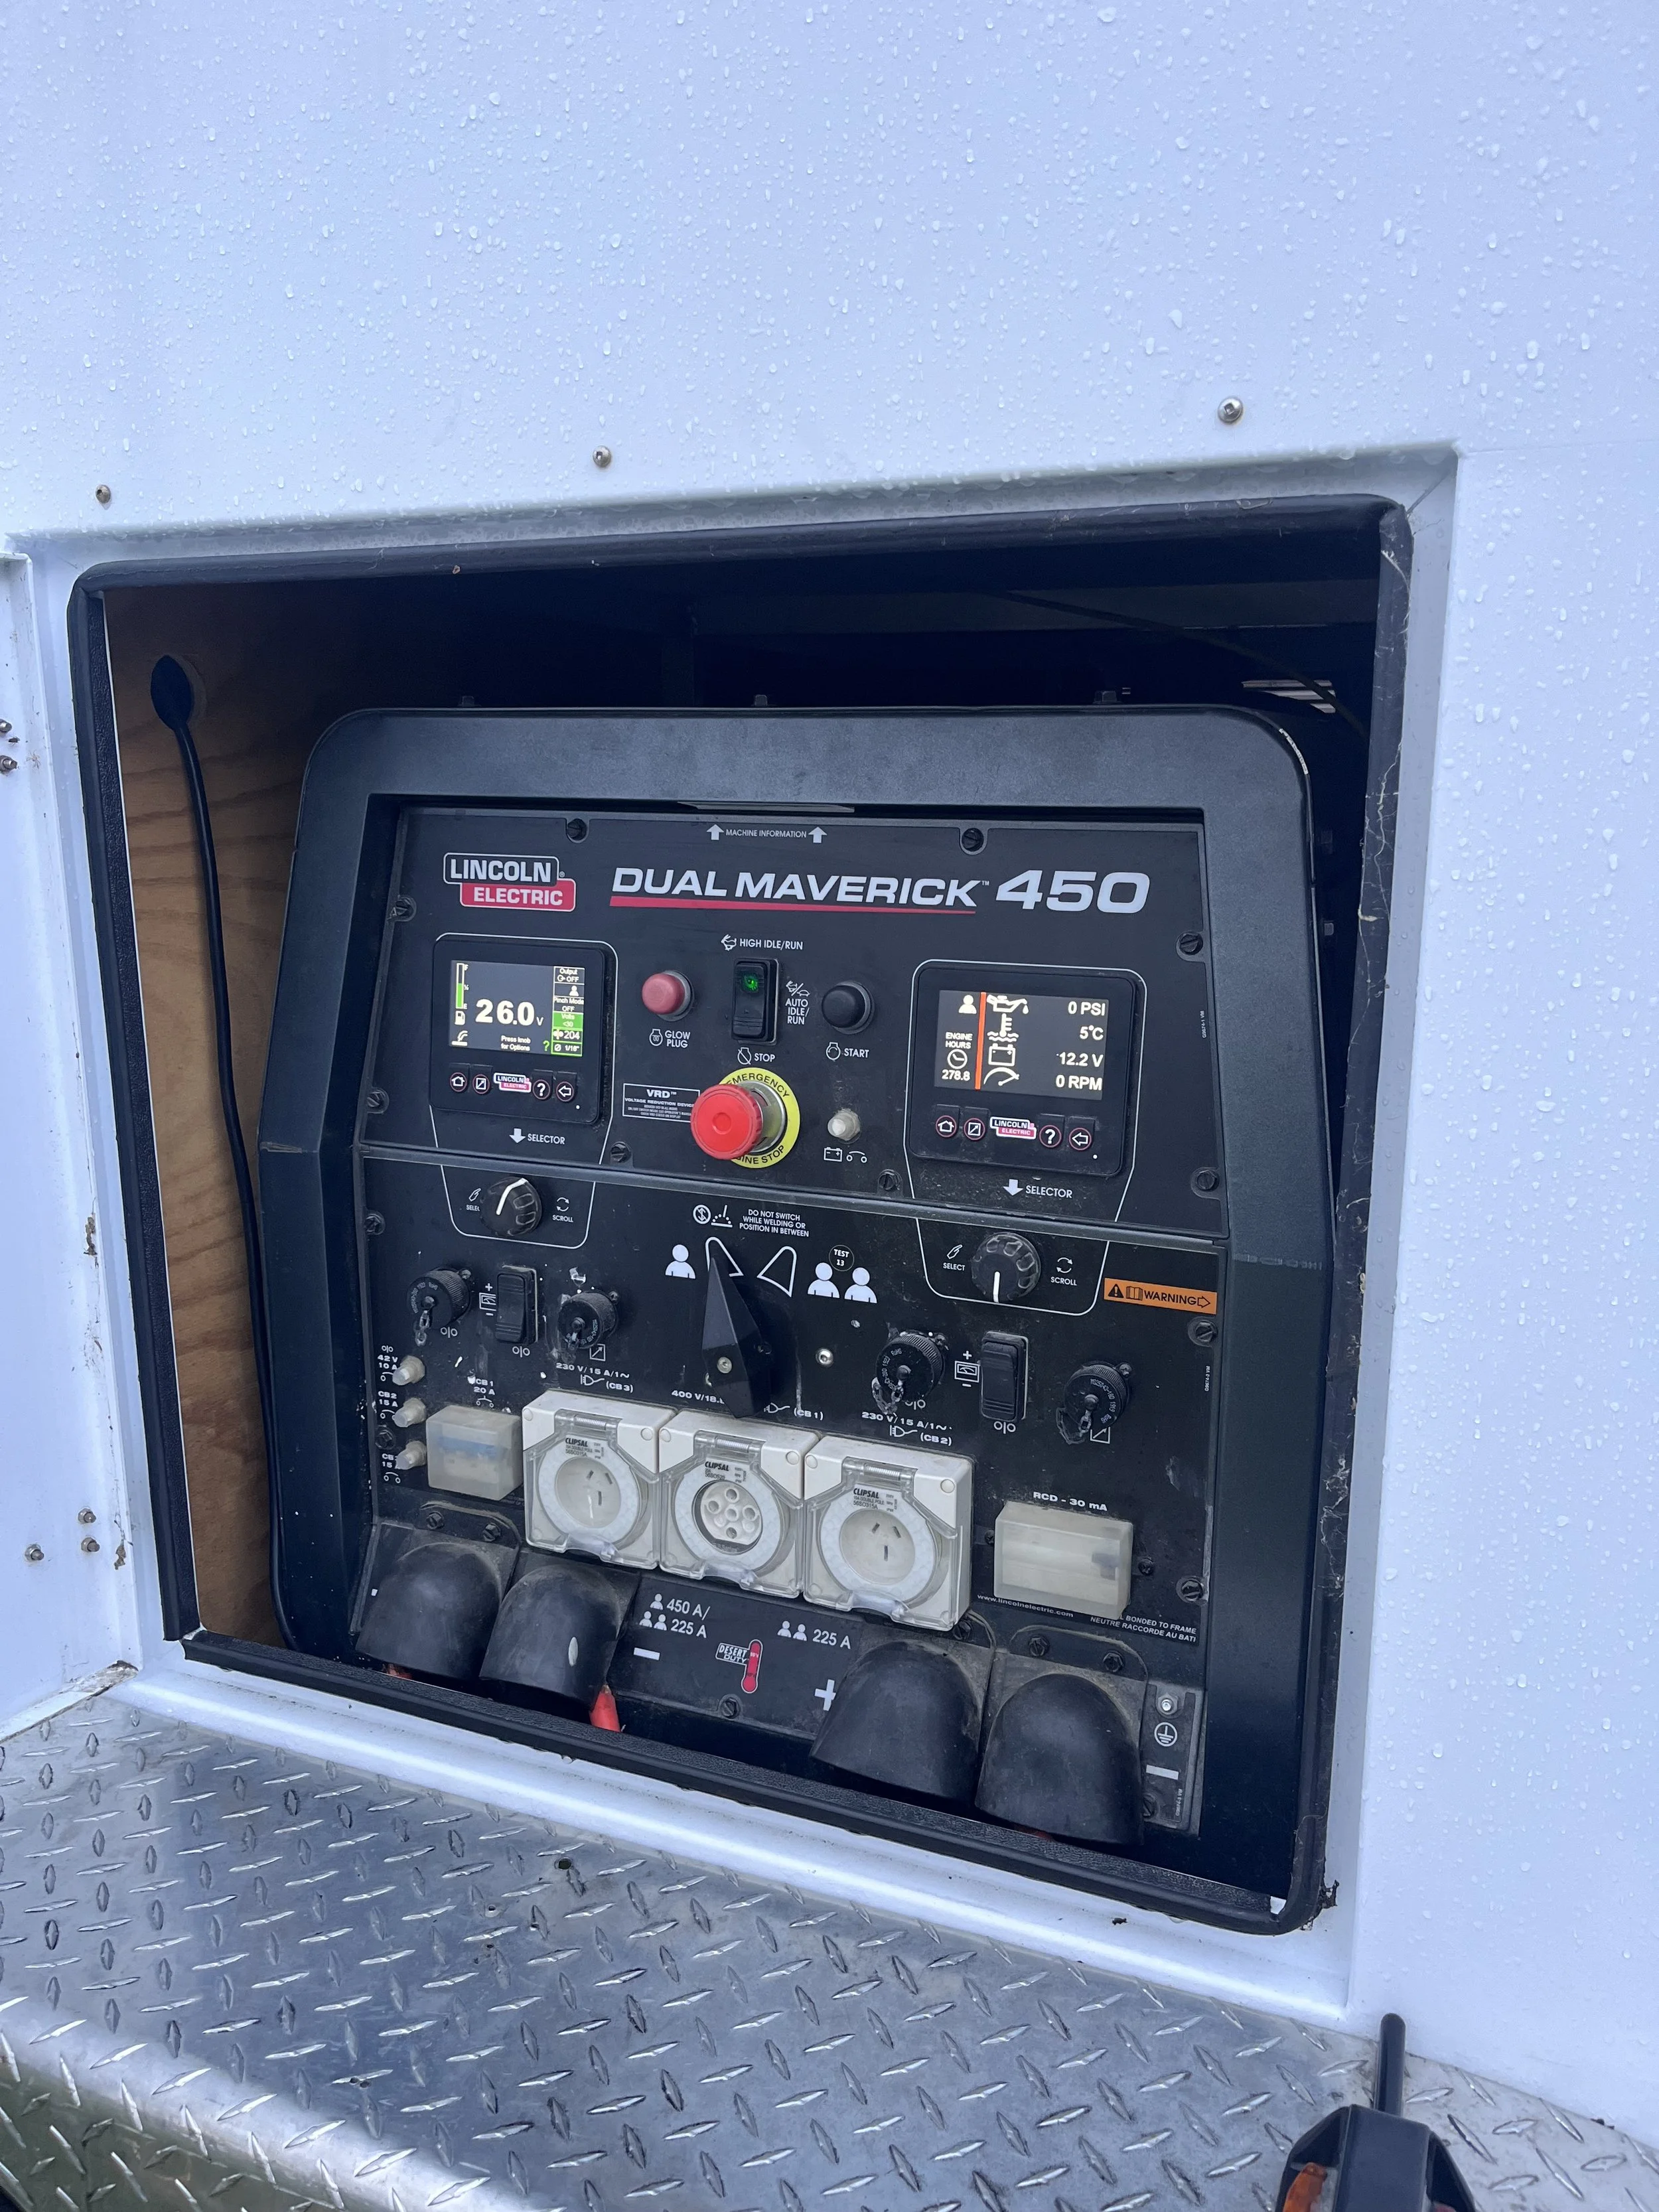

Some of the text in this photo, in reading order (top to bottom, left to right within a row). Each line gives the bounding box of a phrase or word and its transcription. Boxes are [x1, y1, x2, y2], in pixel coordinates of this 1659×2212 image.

[451, 859, 551, 882] LINCOLN
[612, 867, 727, 897] DUAL
[995, 869, 1150, 913] 450
[474, 887, 563, 906] ELECTRIC
[739, 938, 803, 950] HIGH IDLE/RUN
[785, 998, 808, 1007] AUTO
[475, 999, 543, 1026] 26.0 V
[788, 1007, 810, 1017] IDLE/
[1068, 1001, 1105, 1016] 0 PSI
[787, 1015, 804, 1025] RUN
[563, 1031, 580, 1039] 204
[664, 1030, 690, 1039] GLOW
[946, 1032, 973, 1041] ENGINE
[1080, 1025, 1104, 1041] 5°C
[501, 1035, 517, 1043] Press
[666, 1039, 687, 1048] PLUG
[946, 1040, 971, 1049] HOURS
[754, 1053, 775, 1062] STOP
[844, 1048, 869, 1058] START
[1059, 1051, 1103, 1068] 12.2 V
[942, 1069, 970, 1081] 278.8
[1056, 1074, 1102, 1091] 0 RPM
[994, 1120, 1028, 1128] LINCOLN
[528, 1134, 565, 1145] SELECTOR
[762, 1145, 784, 1163] STOP
[1026, 1185, 1072, 1199] SELECTOR
[776, 1212, 800, 1221] SWITCH
[764, 1218, 794, 1228] WELDING
[739, 1222, 770, 1232] POSITION
[780, 1228, 809, 1237] BETWEEN
[834, 1248, 849, 1258] TEST
[943, 1262, 966, 1271] SELECT
[1050, 1276, 1077, 1286] SCROLL
[1144, 1290, 1196, 1305] WARNING
[672, 1390, 692, 1399] 400
[862, 1412, 883, 1421] 230
[565, 1438, 588, 1447] CLIPSAL
[705, 1461, 729, 1471] CLIPSAL
[853, 1488, 879, 1499] CLIPSAL
[1033, 1491, 1058, 1502] RCD
[1069, 1499, 1086, 1507] 30
[1089, 1503, 1108, 1511] mA
[666, 1598, 711, 1621] 450 A/
[977, 1594, 1074, 1618] www.lincolnelectric.com
[671, 1618, 707, 1639] 225 A
[1090, 1617, 1120, 1627] NEUTRE
[1122, 1622, 1165, 1636] RACCORDE
[1125, 1615, 1157, 1627] BONDED
[1170, 1624, 1196, 1635] FRAME
[812, 1629, 851, 1649] 225 A
[719, 1645, 748, 1658] DESERT
[724, 1654, 747, 1663] DUTY
